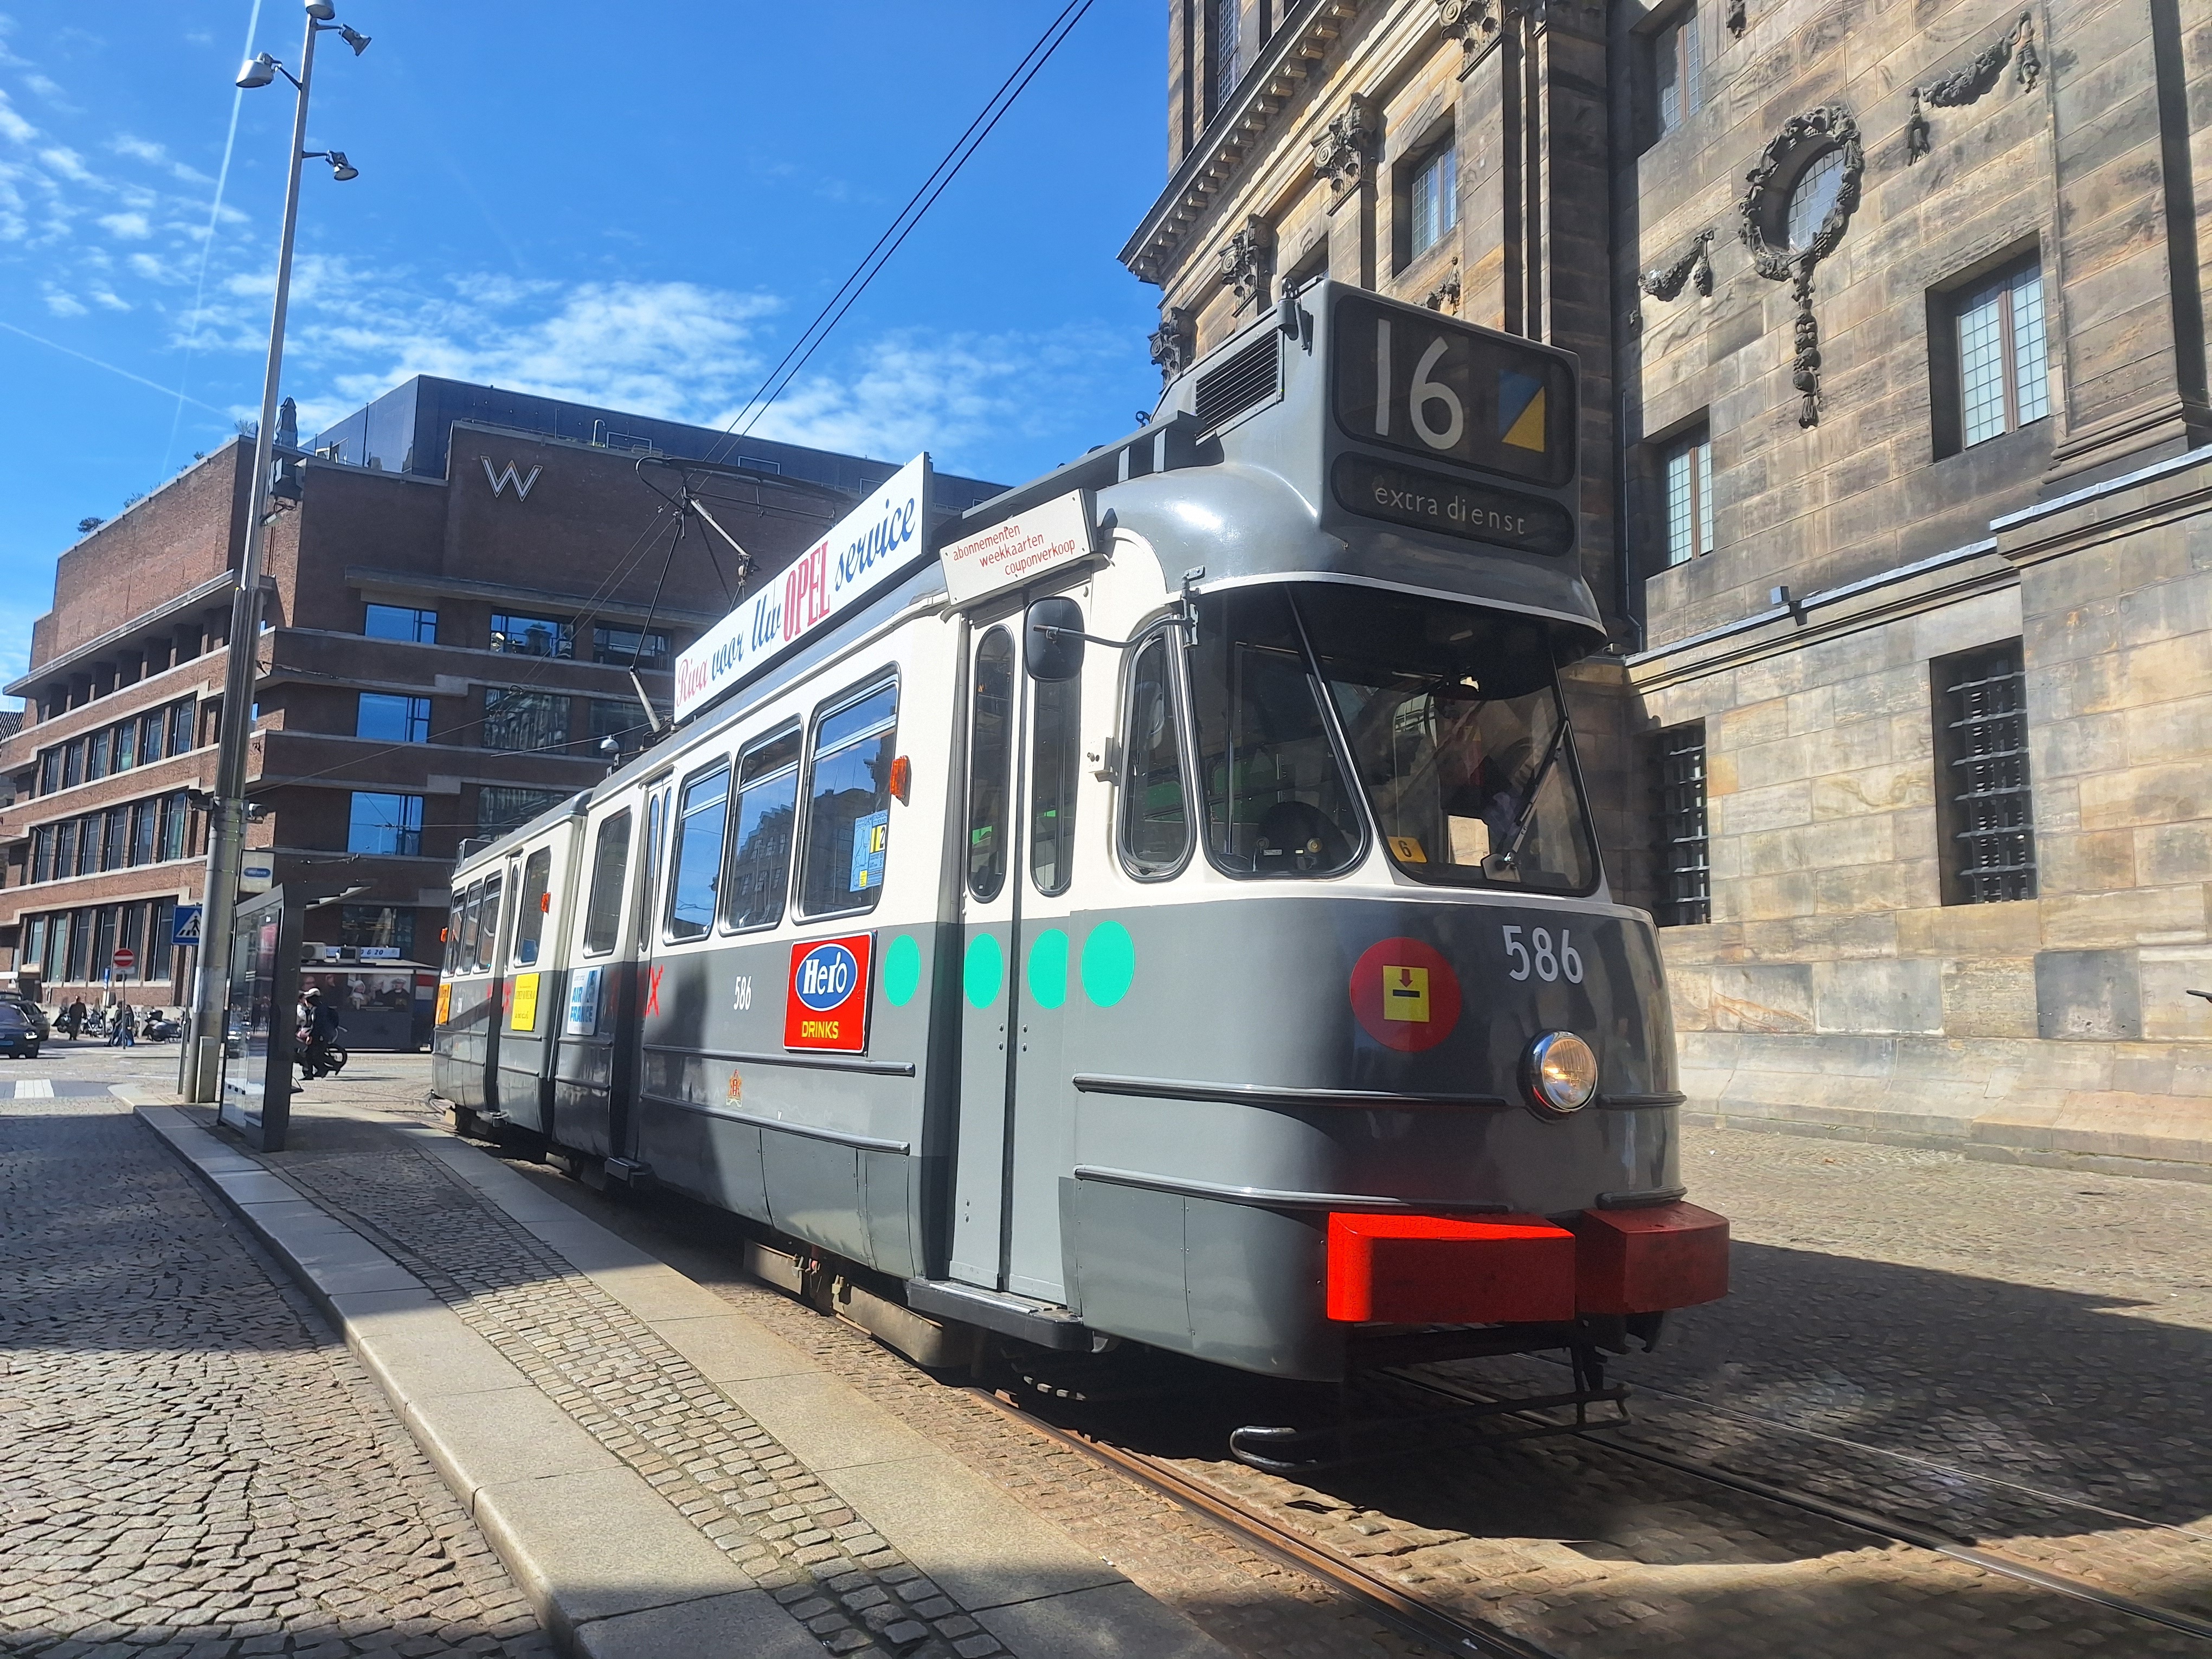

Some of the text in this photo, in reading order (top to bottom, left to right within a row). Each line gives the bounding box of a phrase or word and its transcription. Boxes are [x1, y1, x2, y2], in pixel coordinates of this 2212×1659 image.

[1375, 318, 1464, 451] 16
[480, 455, 543, 503] W
[1374, 486, 1525, 535] extra dienst
[953, 524, 1021, 561] abonnementen
[979, 533, 1044, 568] weekkaarten
[1005, 538, 1076, 576] couponverkoop
[676, 497, 916, 707] Riva voor Uw OPEL service
[1398, 840, 1412, 858] 6
[1502, 924, 1584, 984] 586
[802, 951, 847, 995] Hero
[572, 986, 583, 1003] AIR
[734, 975, 752, 1011] 586
[570, 1006, 594, 1023] FRANCE
[801, 1021, 840, 1039] DRINKS
